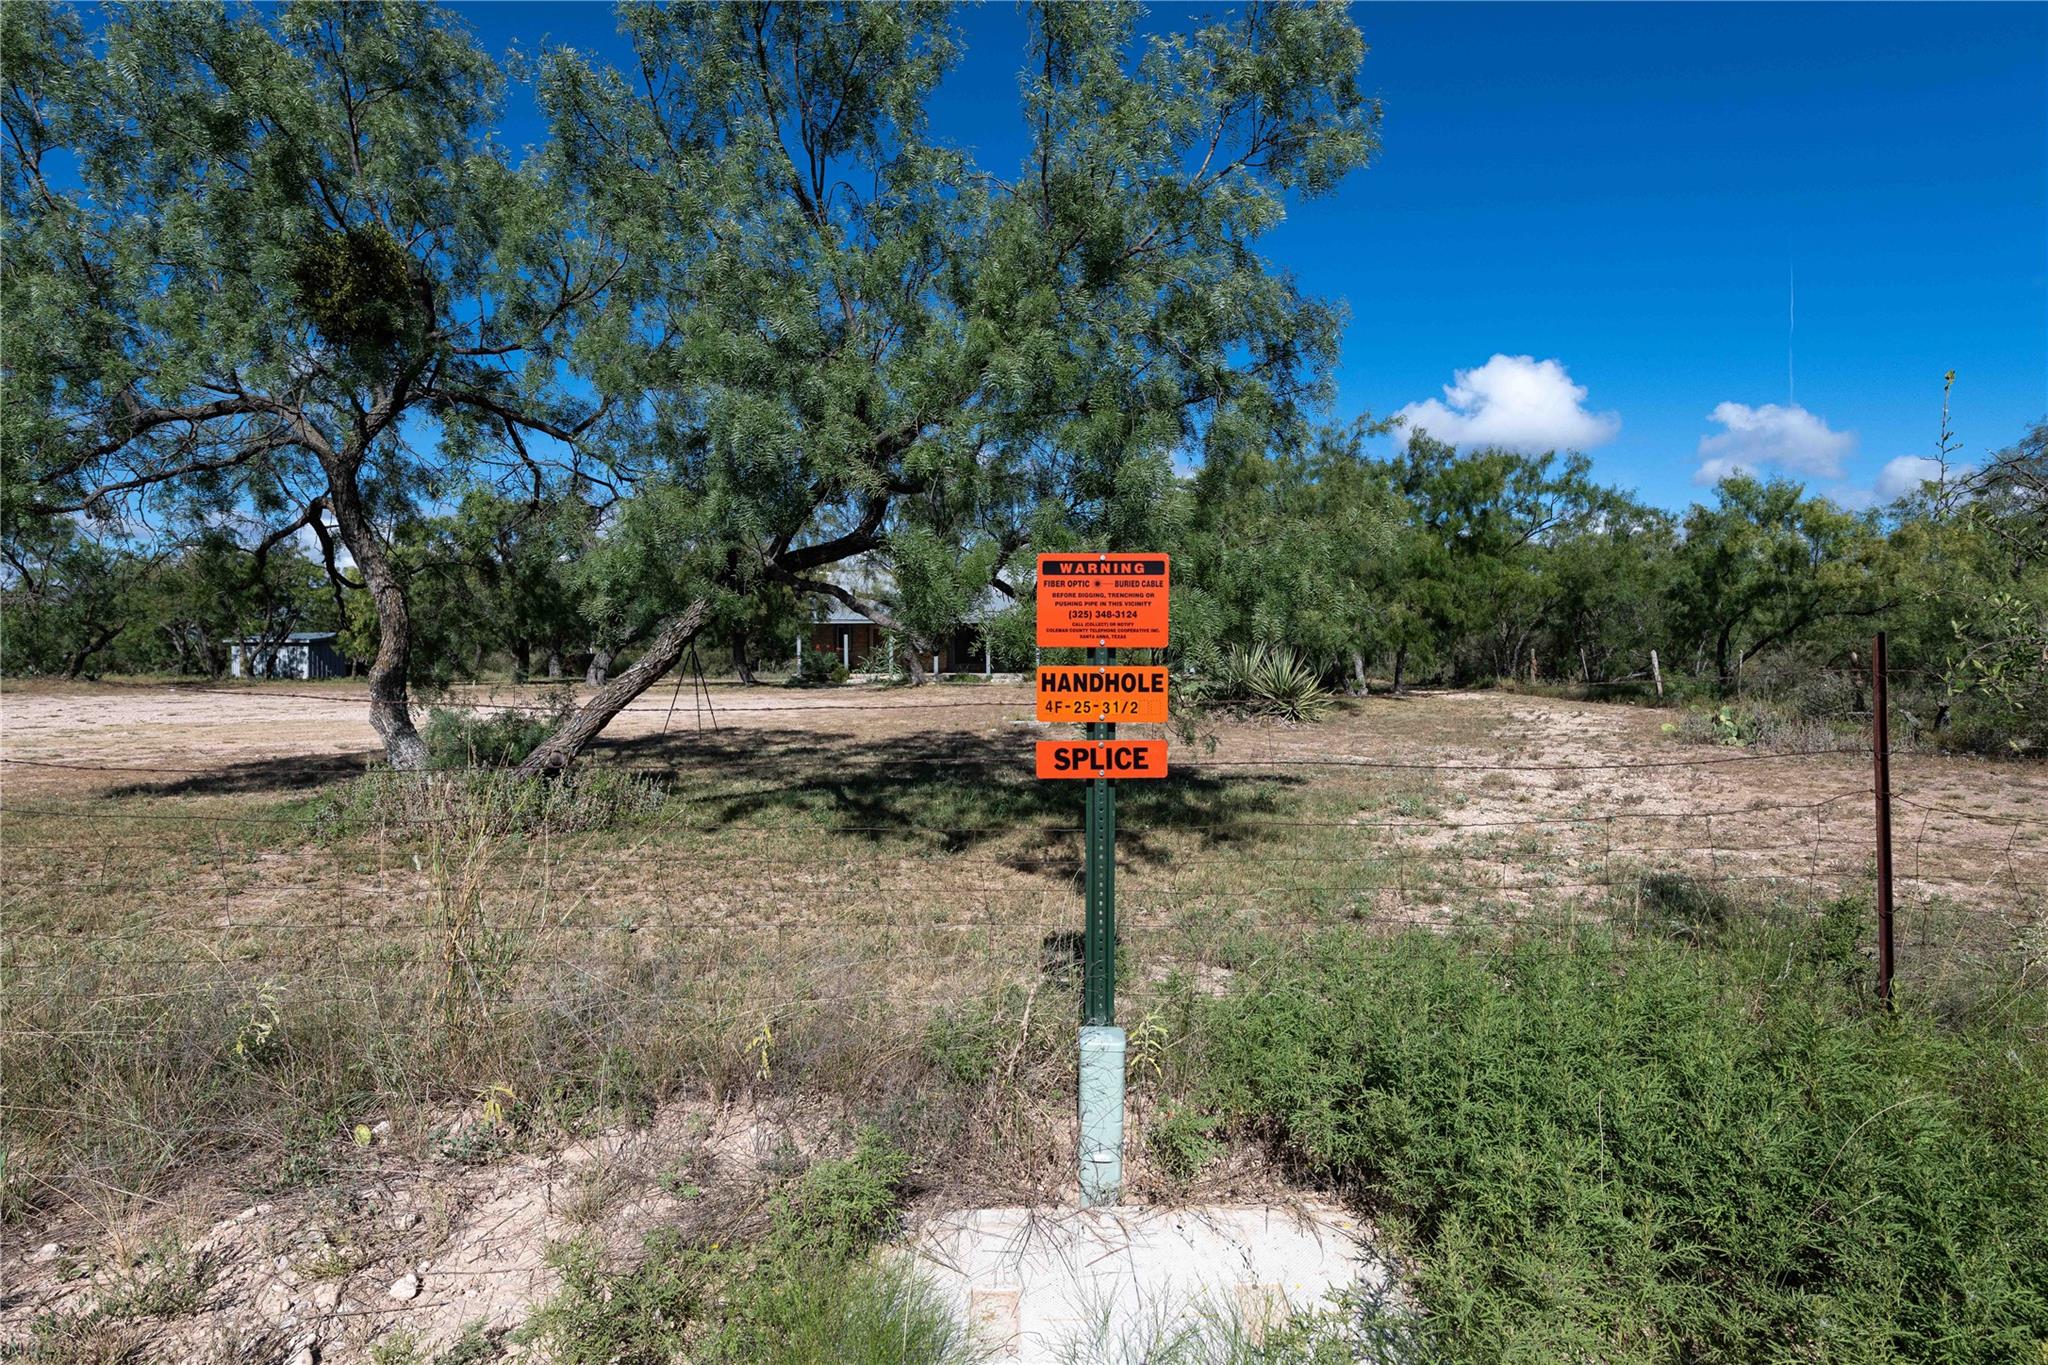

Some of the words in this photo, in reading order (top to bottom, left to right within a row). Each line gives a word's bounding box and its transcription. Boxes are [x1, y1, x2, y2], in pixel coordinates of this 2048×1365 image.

[1060, 563, 1145, 574] WARNING
[1069, 610, 1092, 620] (325)
[1042, 672, 1164, 692] HANDHOLE
[1045, 700, 1138, 714] 4F-25-31/2
[1054, 747, 1149, 770] SPLICE
